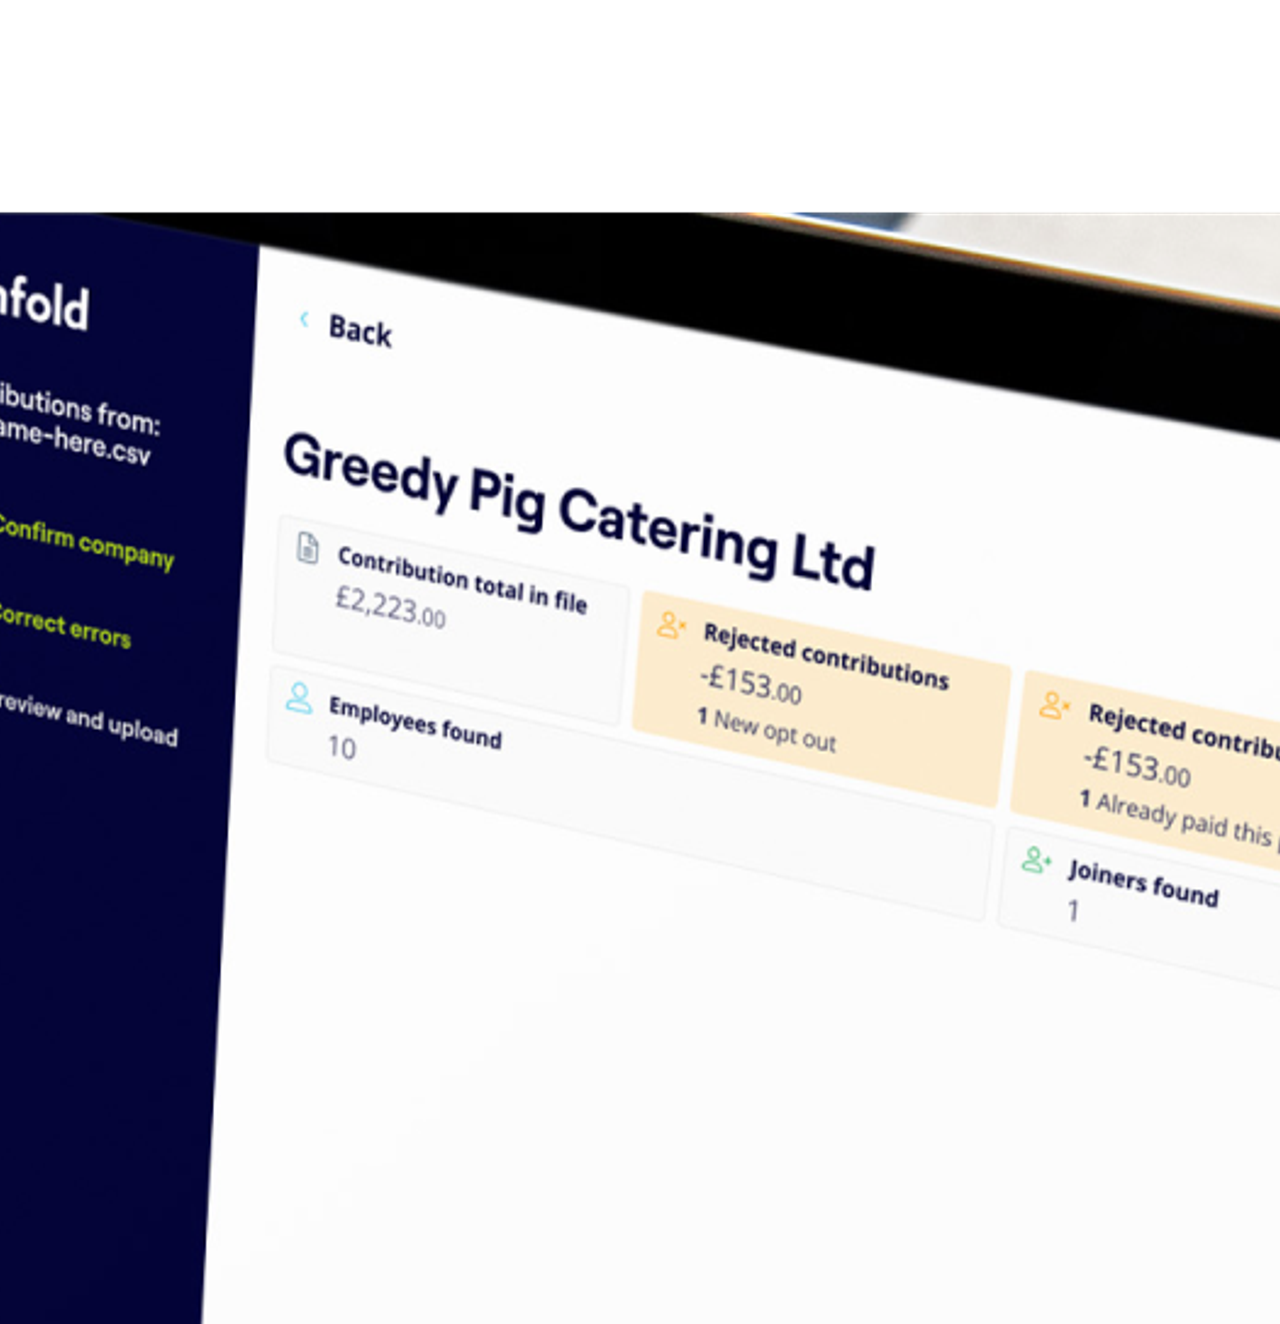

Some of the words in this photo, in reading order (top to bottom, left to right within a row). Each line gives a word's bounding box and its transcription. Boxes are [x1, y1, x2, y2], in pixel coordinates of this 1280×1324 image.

[328, 313, 393, 348] Back
[97, 402, 161, 436] from:
[283, 431, 459, 516] Greedy
[470, 467, 546, 535] Pig
[558, 487, 779, 582] Catering
[791, 532, 876, 591] Ltd
[78, 534, 175, 573] company
[337, 545, 469, 591] Contribution
[473, 574, 524, 602] total
[528, 583, 550, 607] in
[553, 589, 589, 616] file
[334, 584, 447, 631] £2,223.00
[70, 620, 132, 649] errors
[703, 622, 796, 660] Rejected
[800, 639, 950, 692] contributions
[700, 661, 803, 706] -£153.00
[66, 707, 103, 732] and
[108, 716, 178, 748] upload
[328, 695, 438, 738] Employees
[441, 717, 503, 750] found
[697, 705, 710, 725] 1
[713, 709, 762, 737] New
[770, 721, 797, 748] opt
[801, 731, 838, 754] out
[1089, 702, 1185, 742] Rejected
[327, 734, 358, 761] 10
[1084, 745, 1191, 791] -£153.00
[1079, 788, 1090, 807] 1
[1094, 791, 1176, 830] Already
[1181, 810, 1227, 840] paid
[1233, 818, 1272, 846] this
[1068, 858, 1147, 898] Joiners
[1152, 876, 1220, 909] found
[1066, 900, 1078, 922] 1
